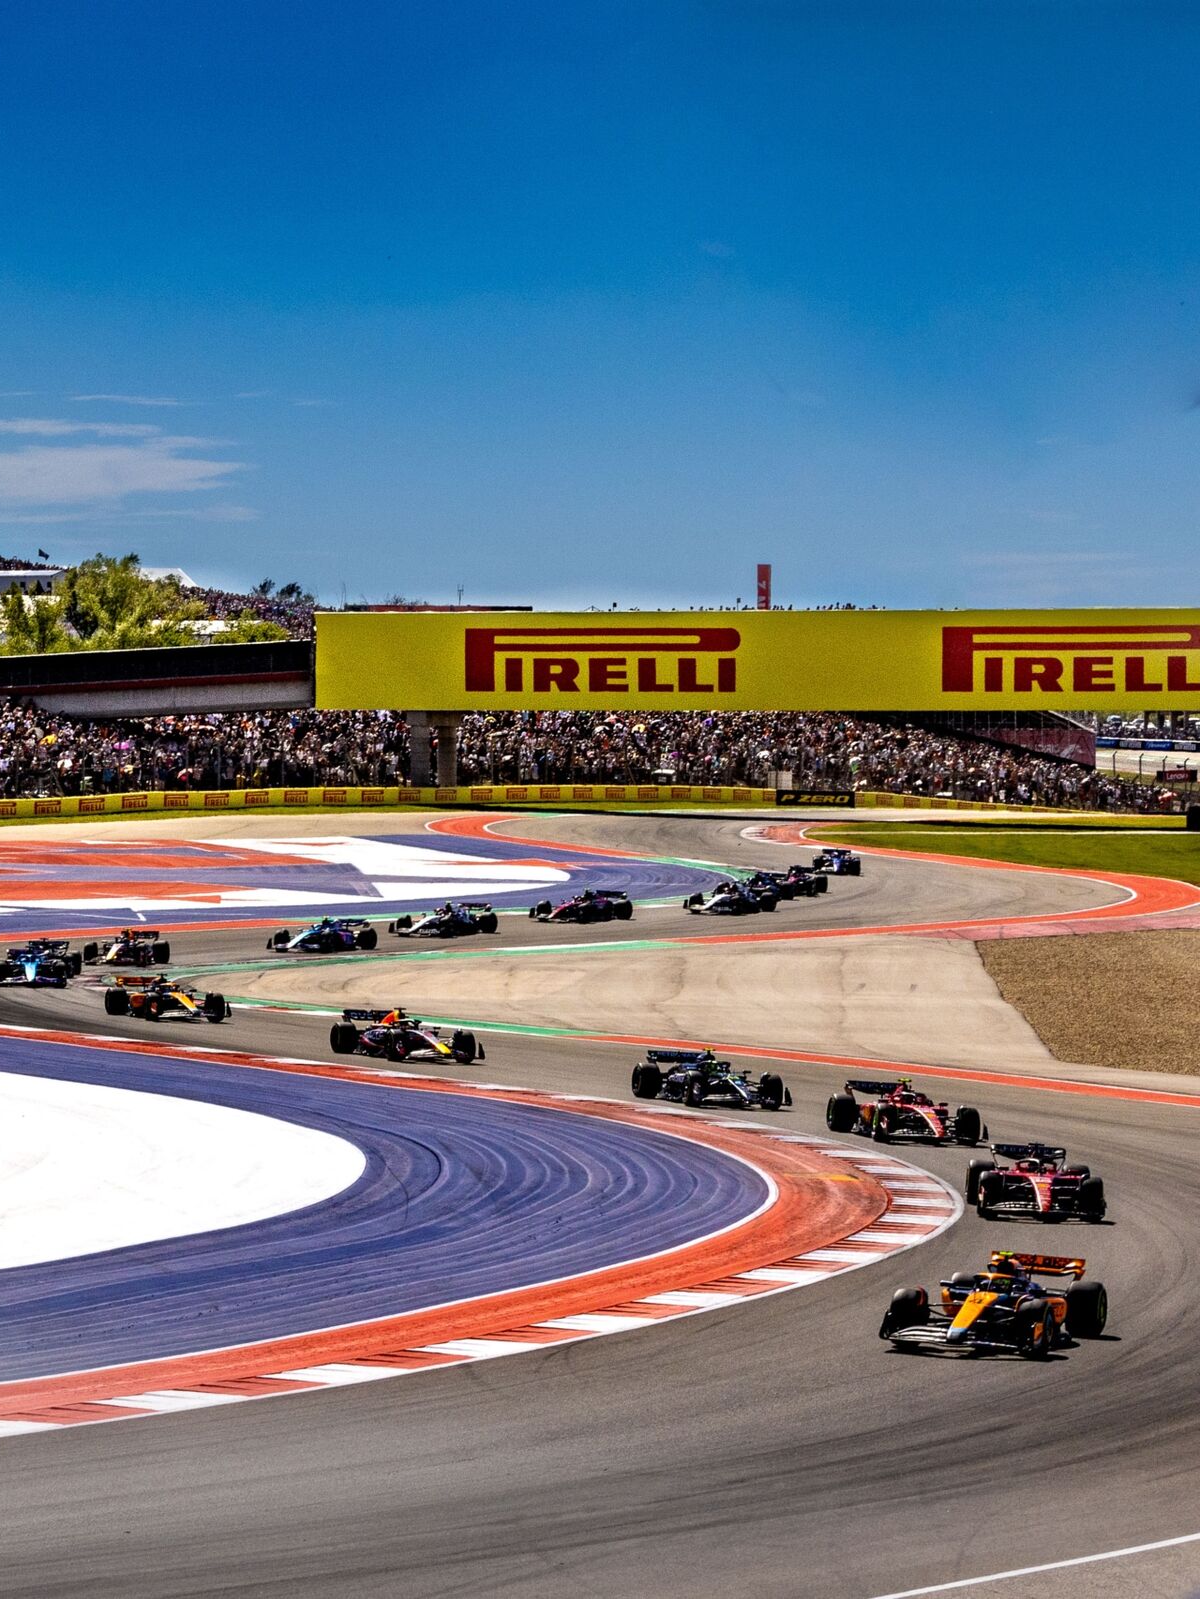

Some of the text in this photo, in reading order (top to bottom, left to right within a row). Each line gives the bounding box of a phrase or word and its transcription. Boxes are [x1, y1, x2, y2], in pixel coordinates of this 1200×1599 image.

[465, 627, 741, 692] PIRELLI
[942, 625, 1200, 693] PIRELL
[122, 795, 147, 809] PIRELLI
[164, 793, 189, 807] PIRELLI
[205, 793, 229, 806] PIRELLI
[245, 791, 269, 804] PIRELLI
[284, 790, 308, 803] PIRELLI
[781, 795, 795, 803] P
[797, 795, 850, 804] ZERO
[35, 800, 62, 814] PIRELLI
[78, 799, 105, 812] PIRELLI
